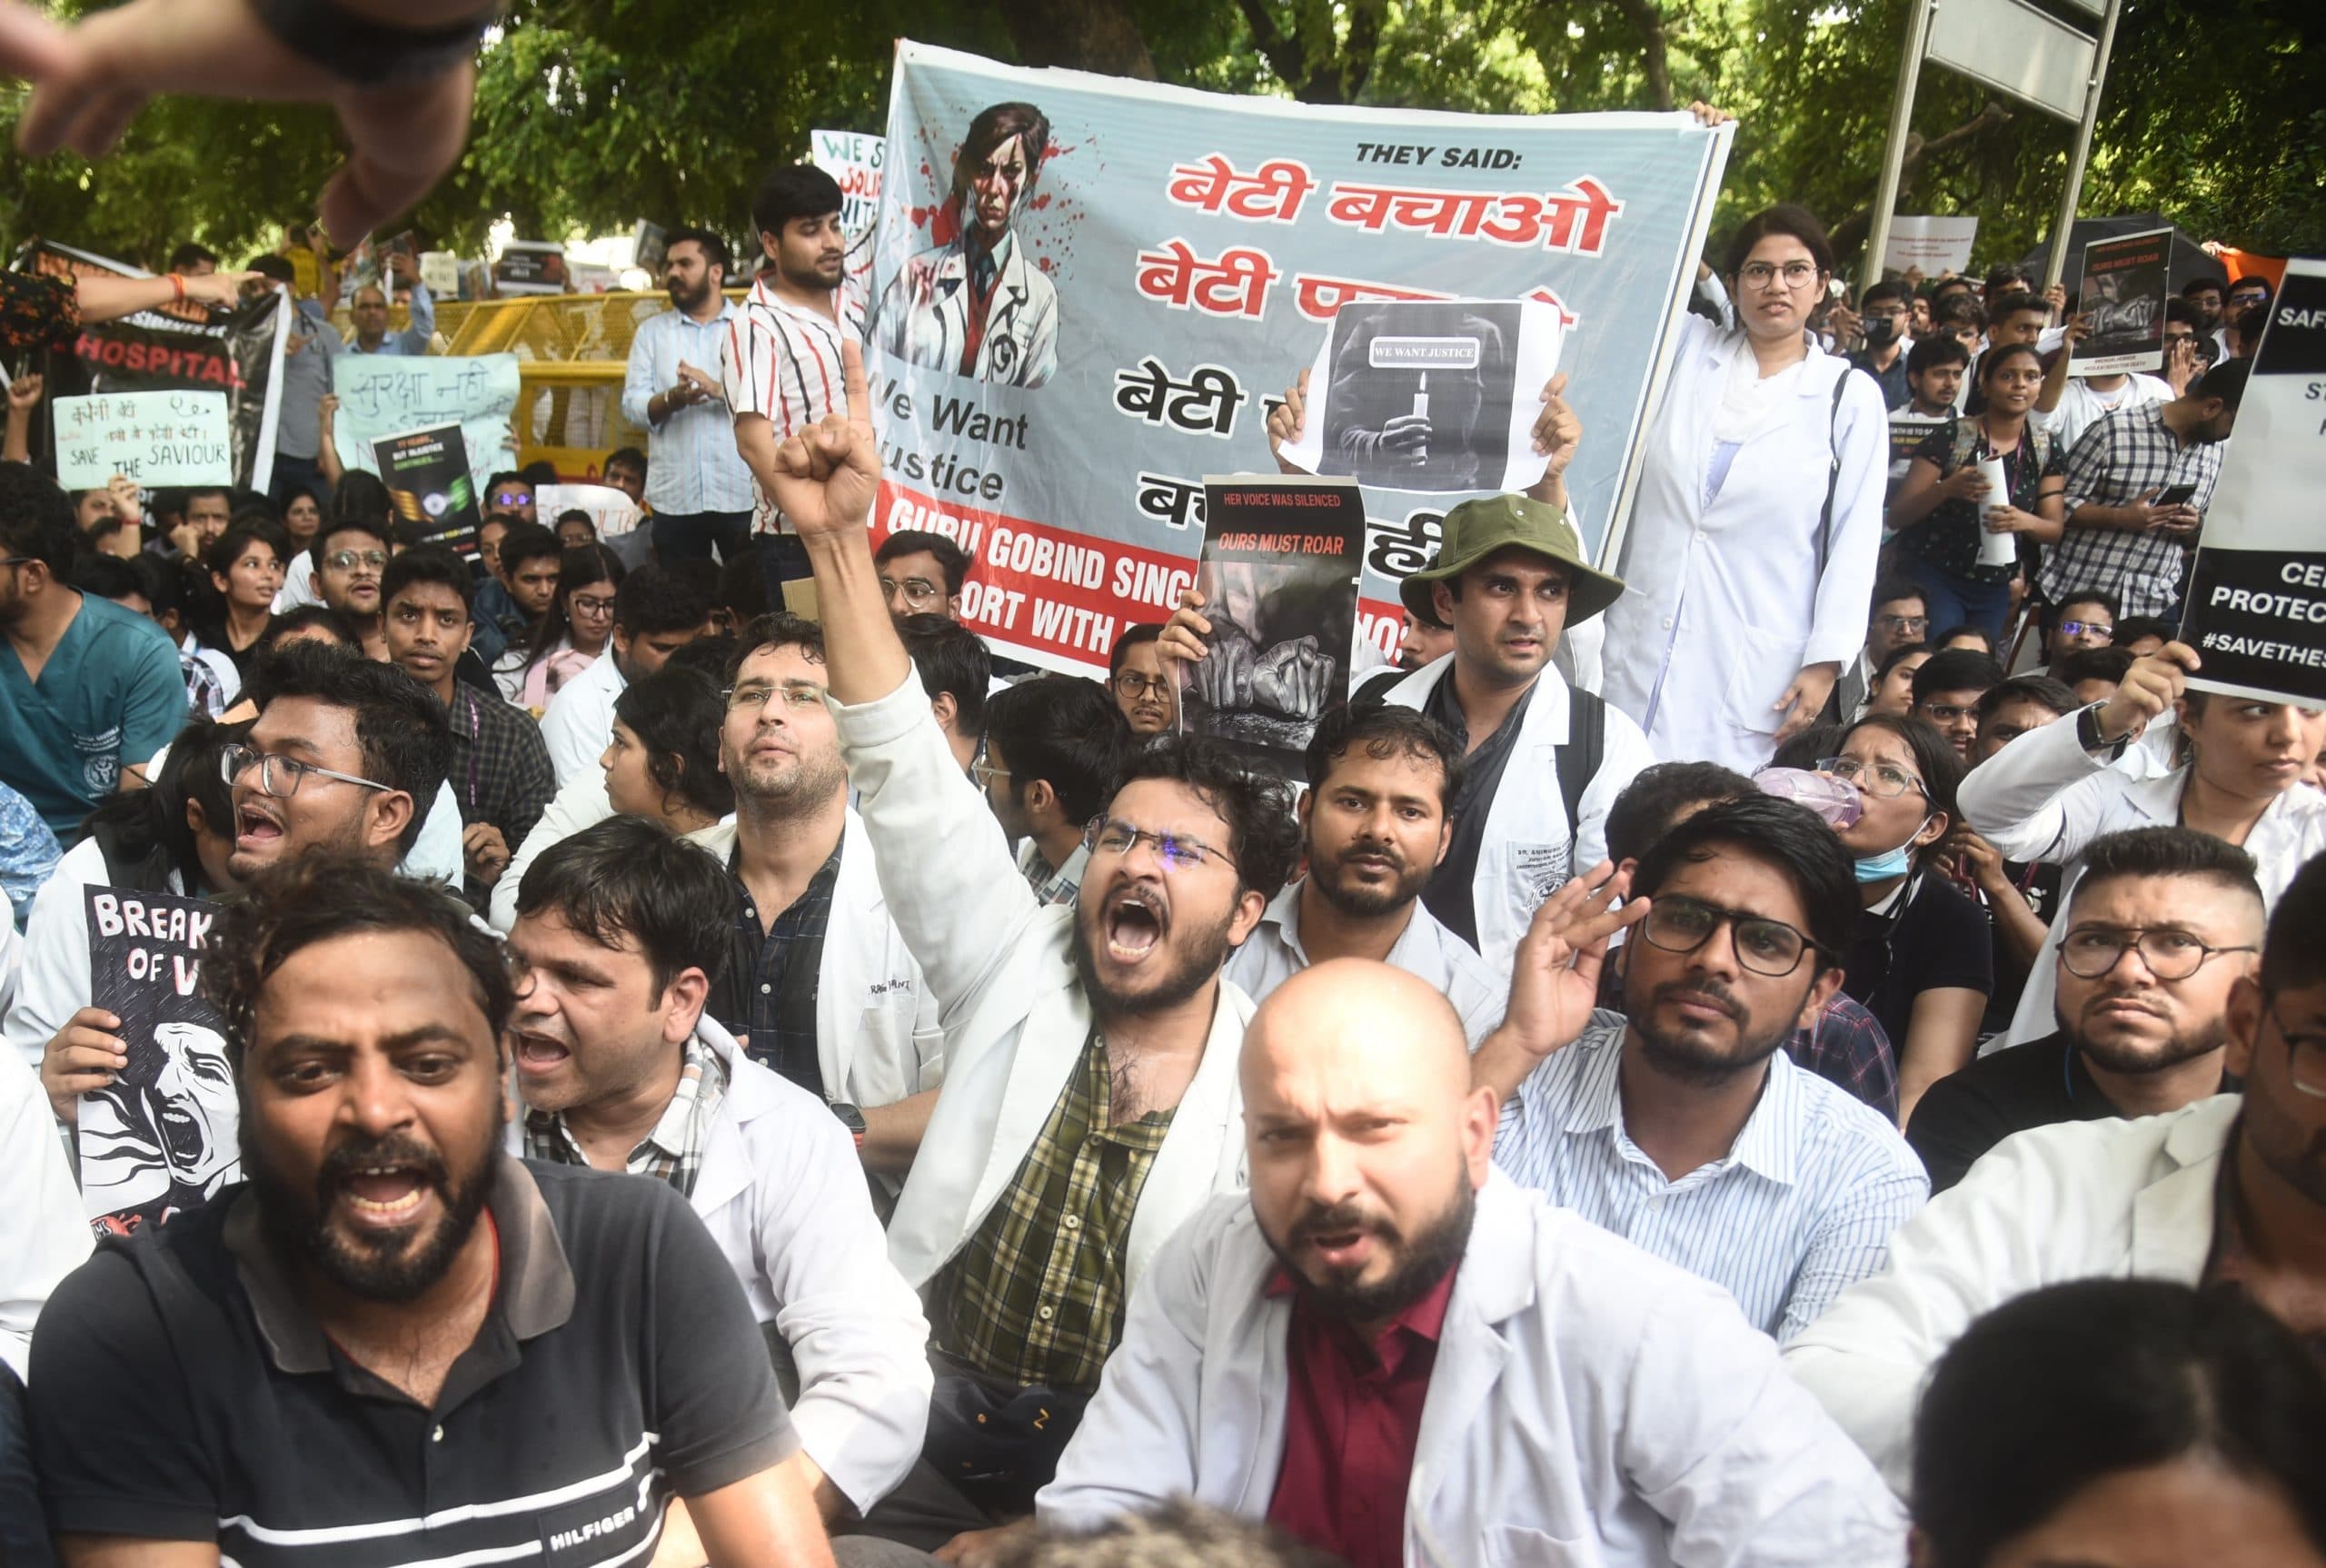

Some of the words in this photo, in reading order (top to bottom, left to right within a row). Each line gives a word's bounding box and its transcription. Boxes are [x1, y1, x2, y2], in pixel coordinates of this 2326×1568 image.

[823, 134, 862, 162] WE
[1357, 143, 1436, 167] THEY
[1440, 147, 1523, 170] SAID:
[1168, 155, 1317, 223] बेटी
[1327, 178, 1620, 254] बचाओ
[1135, 243, 1277, 321] बेटी
[2277, 306, 2326, 330] SAF
[73, 332, 248, 389] HOSPITAL
[1375, 347, 1396, 357] WE
[1395, 348, 1427, 357] WANT
[1427, 348, 1474, 358] JUSTICE
[1116, 358, 1246, 435] बेटी
[931, 393, 1029, 451] Want
[71, 447, 100, 466] SAVE
[113, 458, 143, 478] THE
[147, 443, 226, 466] SAVIOUR
[881, 440, 1004, 501] ustice
[1224, 493, 1242, 505] HER
[1243, 493, 1270, 506] VOICE
[1271, 494, 1294, 506] WAS
[1295, 494, 1341, 508] SILENCED
[987, 527, 1106, 590] GOBIND
[1218, 532, 1257, 551] OURS
[1257, 534, 1302, 553] MUST
[1302, 535, 1345, 555] ROAR
[2281, 561, 2326, 589] CE
[959, 581, 1026, 630] ORT
[1032, 599, 1115, 656] WITH
[94, 893, 213, 950] BREAK
[128, 948, 164, 983] OF
[174, 955, 200, 997] V
[550, 1506, 635, 1551] HILFIGER
